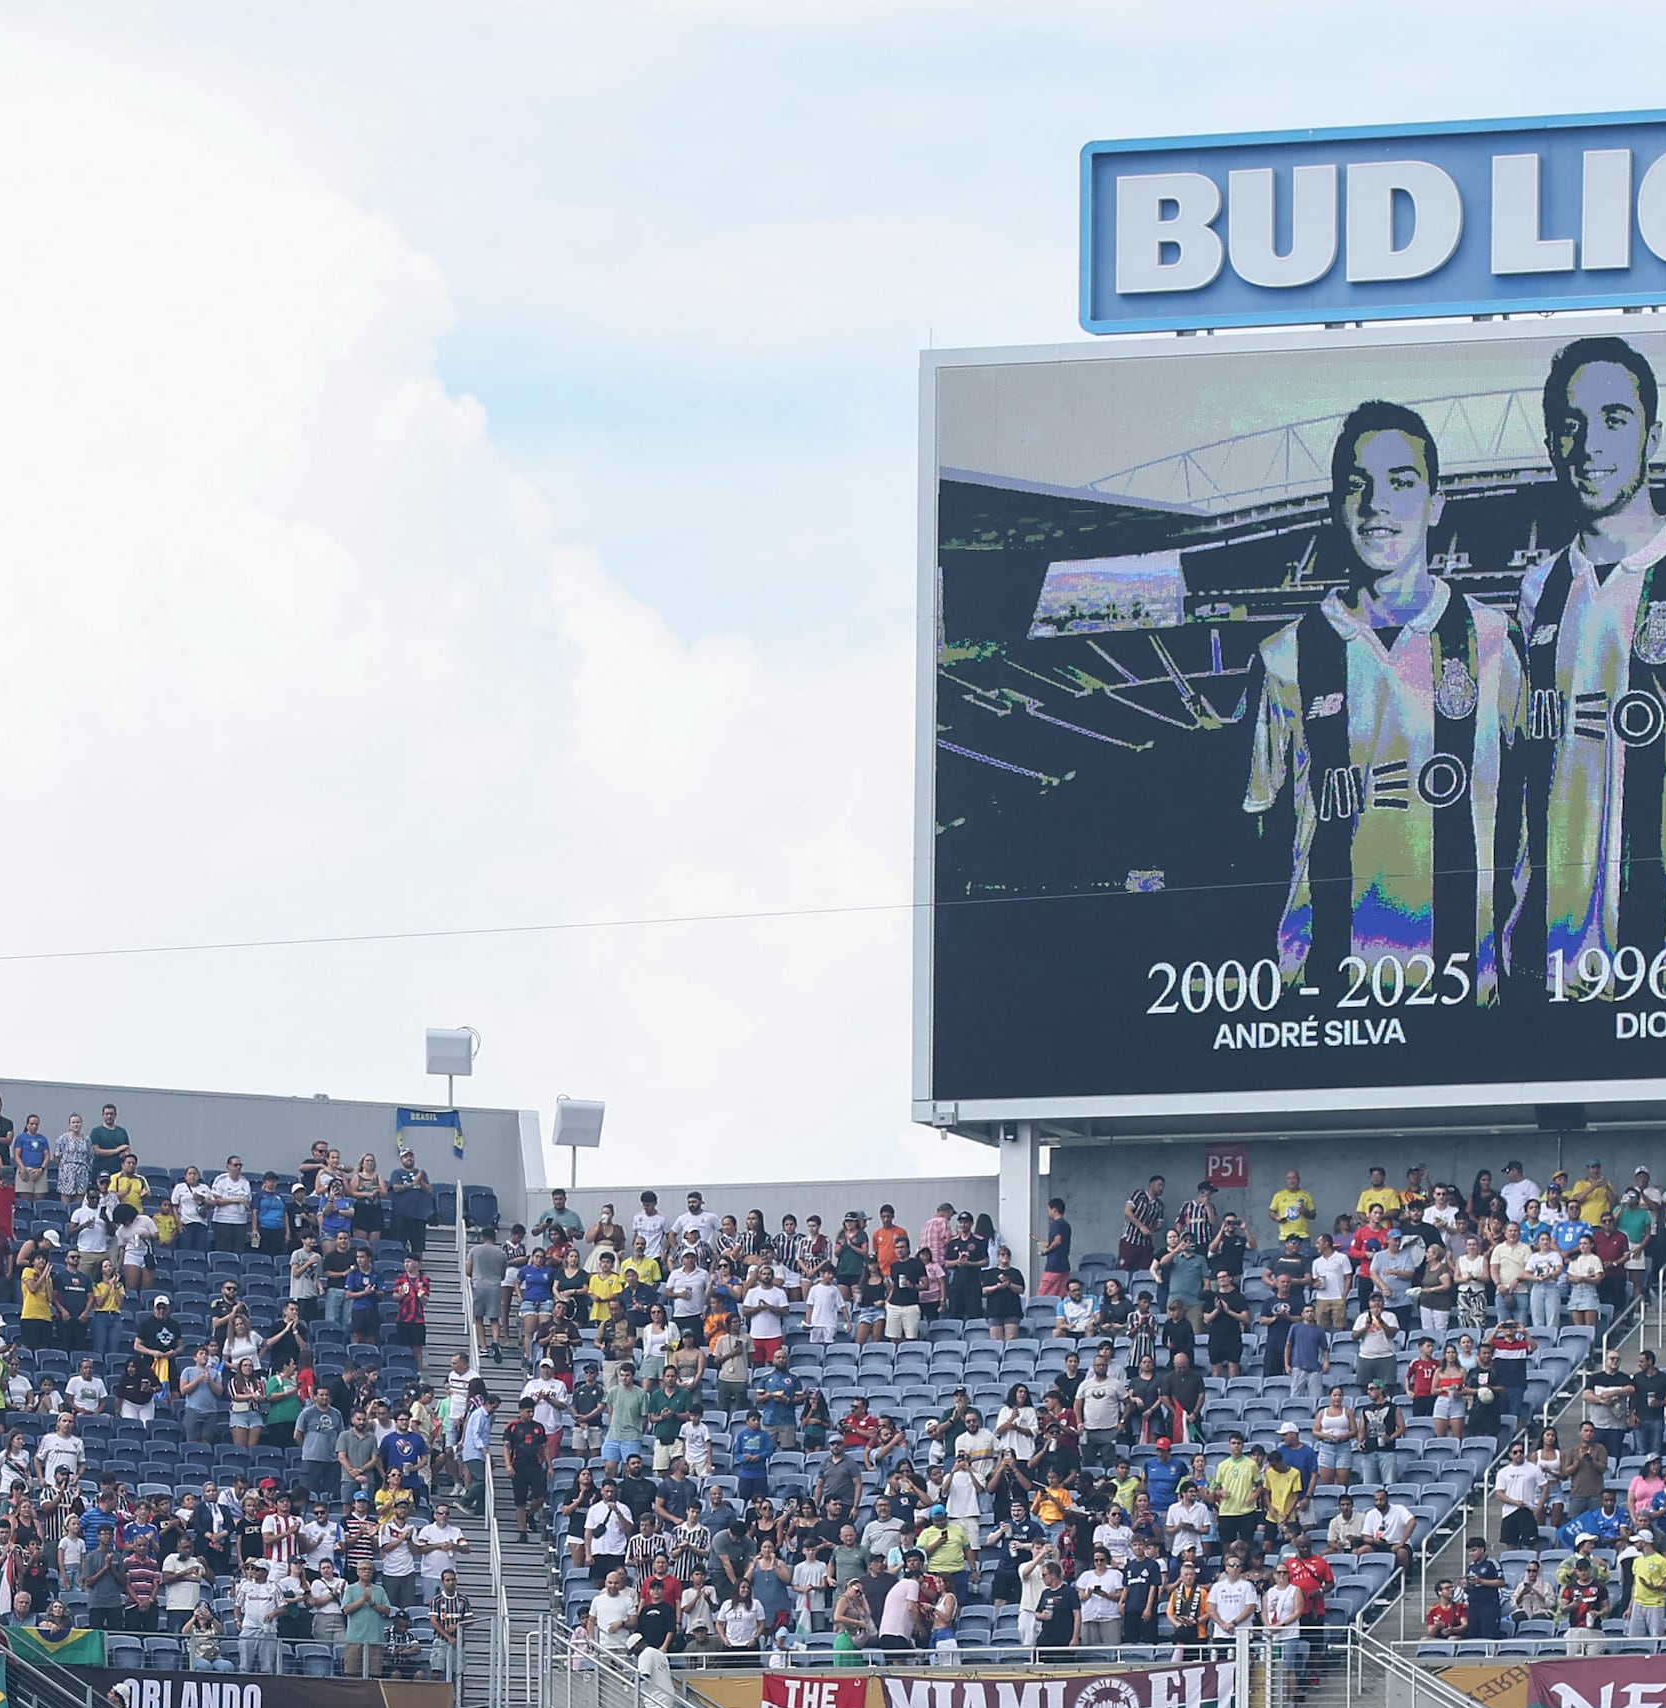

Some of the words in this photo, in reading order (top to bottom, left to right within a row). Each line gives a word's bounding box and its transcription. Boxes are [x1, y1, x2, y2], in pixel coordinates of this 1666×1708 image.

[1115, 159, 1465, 296] BUD
[1146, 960, 1284, 1016] 2000
[1299, 986, 1321, 997] -
[1336, 952, 1472, 1012] 2025
[1213, 1013, 1319, 1050] ANDRÉ
[1323, 1018, 1407, 1047] SILVA
[410, 1112, 438, 1121] BRASIL
[1208, 1155, 1243, 1178] P51
